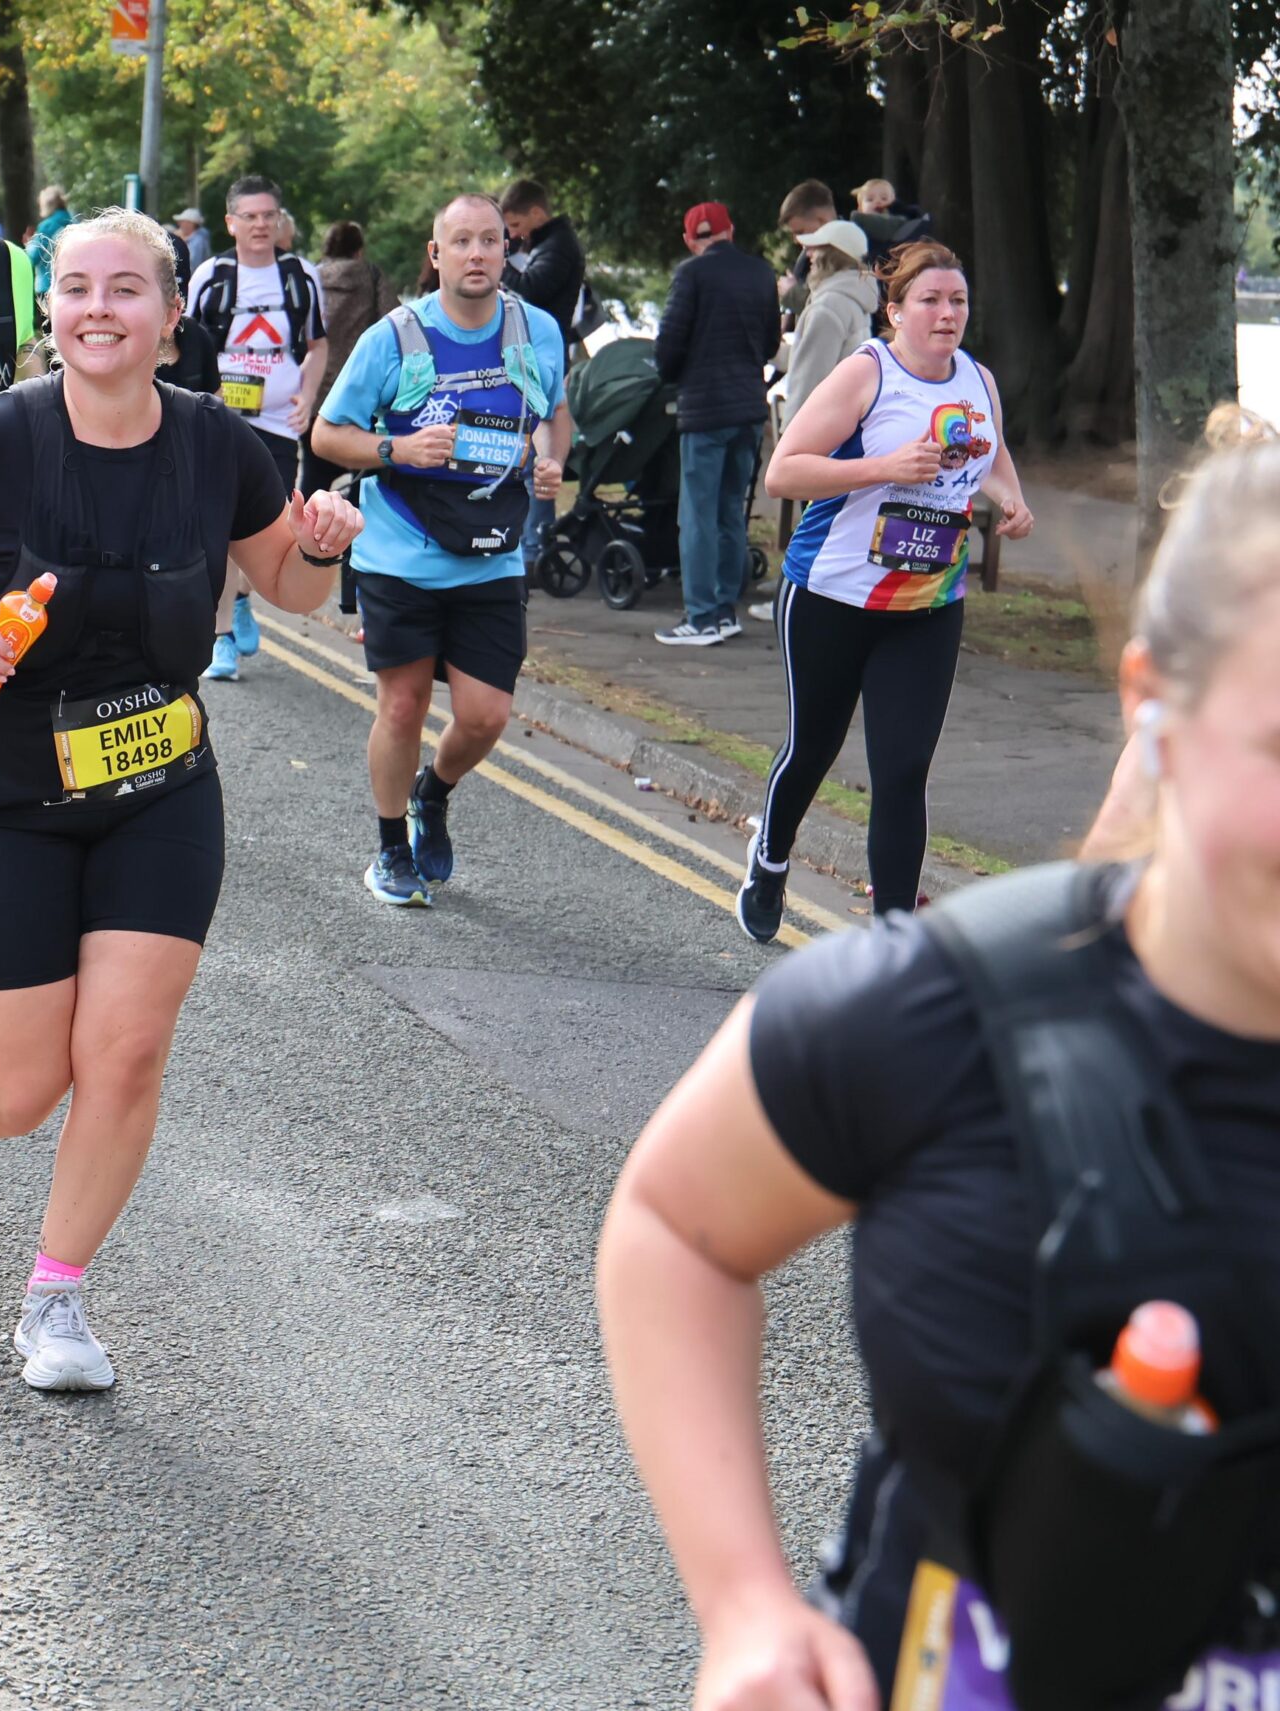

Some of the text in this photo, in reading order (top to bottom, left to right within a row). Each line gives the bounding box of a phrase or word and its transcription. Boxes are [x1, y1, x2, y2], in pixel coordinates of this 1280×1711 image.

[474, 415, 514, 430] OYSHO
[468, 445, 511, 464] 24785
[907, 508, 950, 525] OYSHO
[472, 537, 502, 549] PUMA
[912, 527, 936, 543] LIZ
[895, 541, 941, 559] 27625
[96, 687, 162, 718] OYSHO
[99, 713, 168, 751] EMILY
[102, 738, 173, 776] 18498
[134, 768, 166, 784] OYSHO
